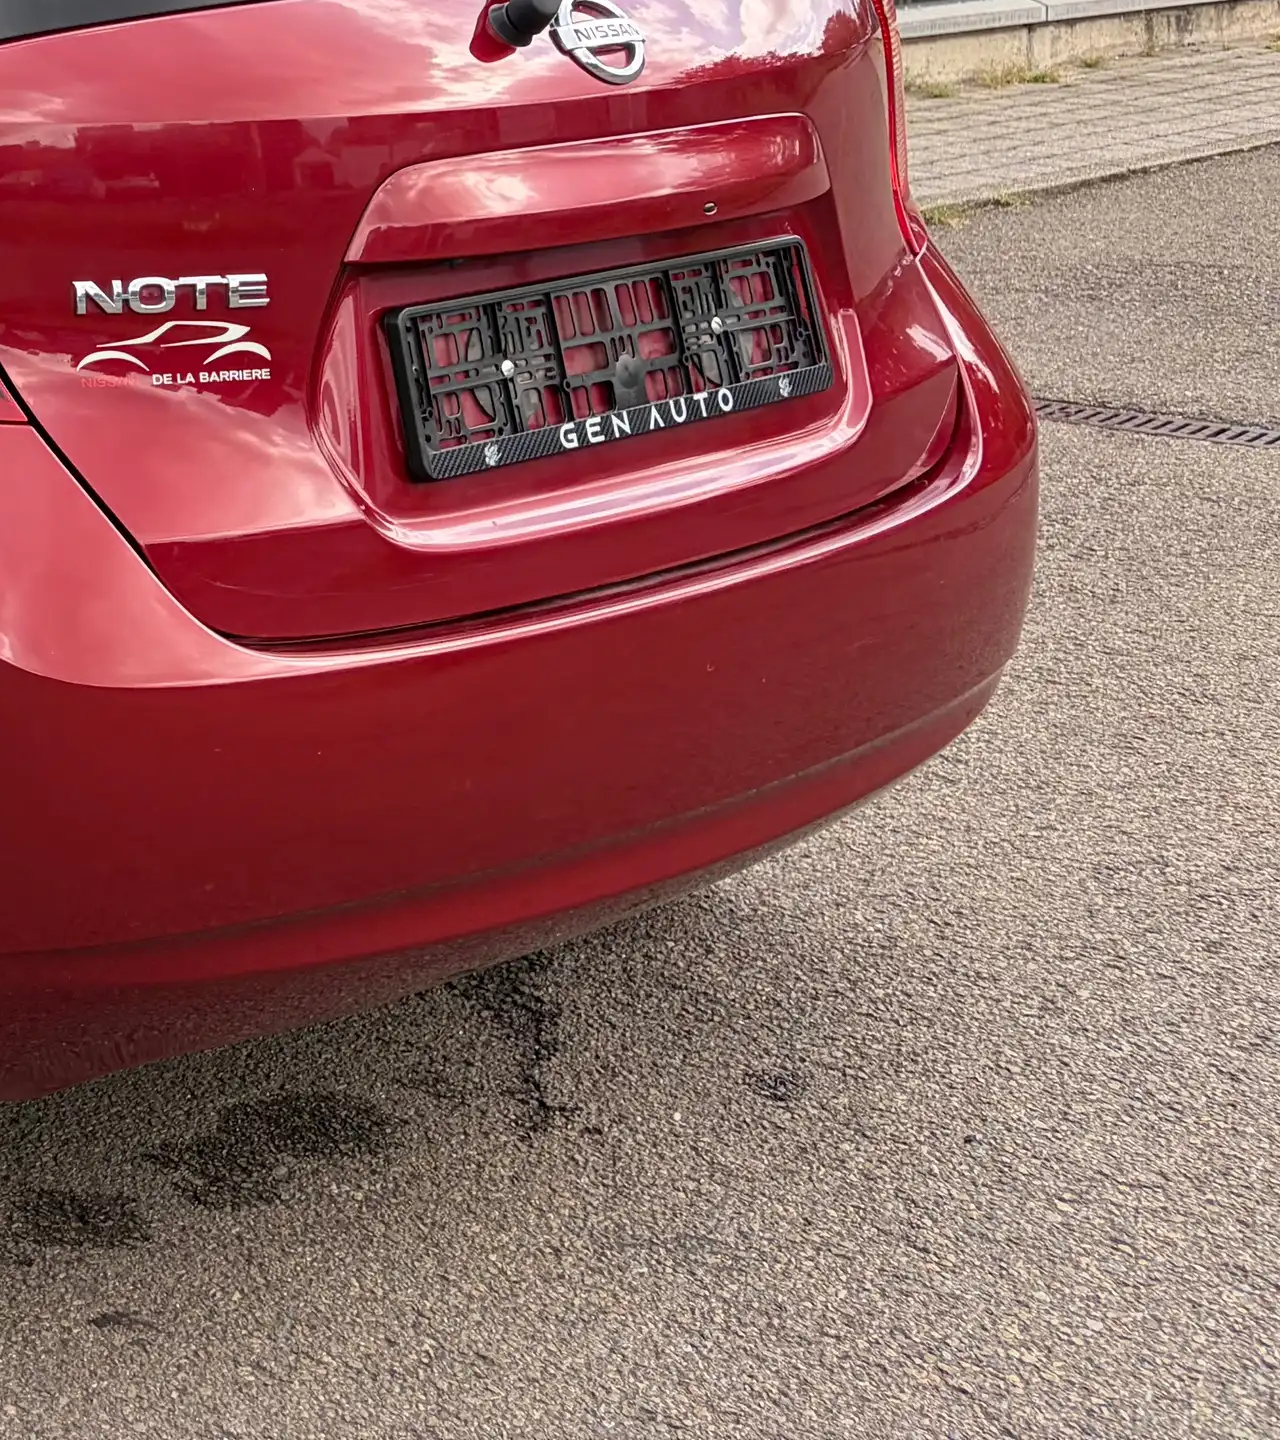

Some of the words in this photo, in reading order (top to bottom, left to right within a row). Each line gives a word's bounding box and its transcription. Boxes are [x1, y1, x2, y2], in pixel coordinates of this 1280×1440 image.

[573, 23, 640, 42] NISSAN
[72, 273, 271, 315] NOTE
[152, 373, 173, 385] DE
[177, 372, 196, 384] LA
[559, 415, 632, 449] GEN
[649, 388, 734, 430] AUTO
